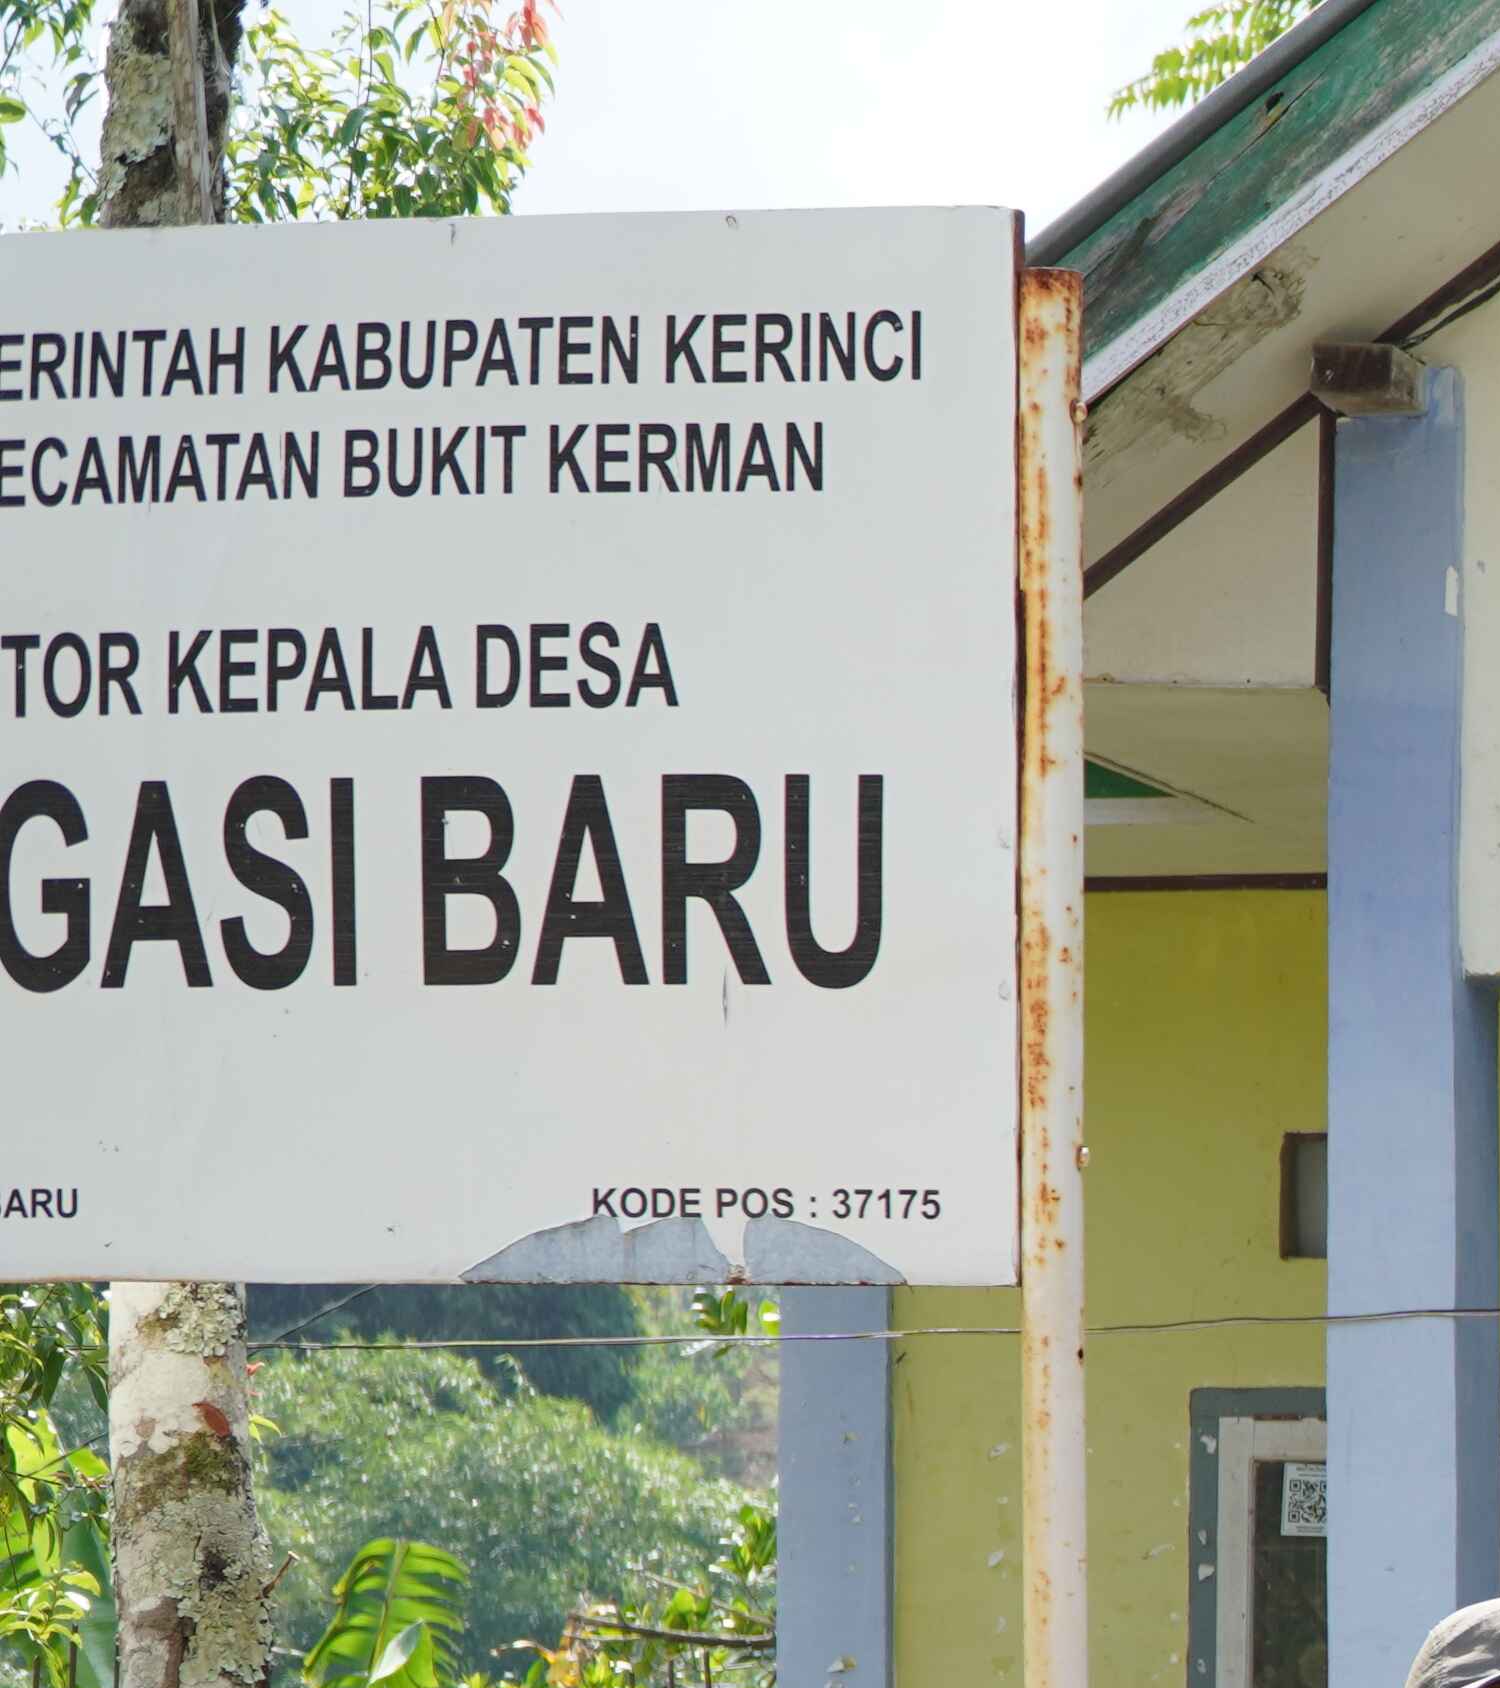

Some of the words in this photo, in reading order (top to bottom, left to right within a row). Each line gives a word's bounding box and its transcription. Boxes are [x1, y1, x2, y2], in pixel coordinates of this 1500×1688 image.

[270, 316, 639, 393] KABUPATEN
[666, 310, 922, 384] KERINCI
[344, 426, 527, 498] BUKIT
[550, 422, 824, 494] KERMAN
[1, 633, 142, 719] TOR
[169, 626, 453, 714] KEPALA
[477, 622, 679, 709] DESA
[0, 775, 357, 994] GASI
[421, 774, 884, 990] BARU
[0, 1188, 79, 1219] ARU
[592, 1188, 702, 1219] KODE
[717, 1187, 794, 1219] POS
[810, 1195, 818, 1218] :
[833, 1187, 941, 1220] 37175
